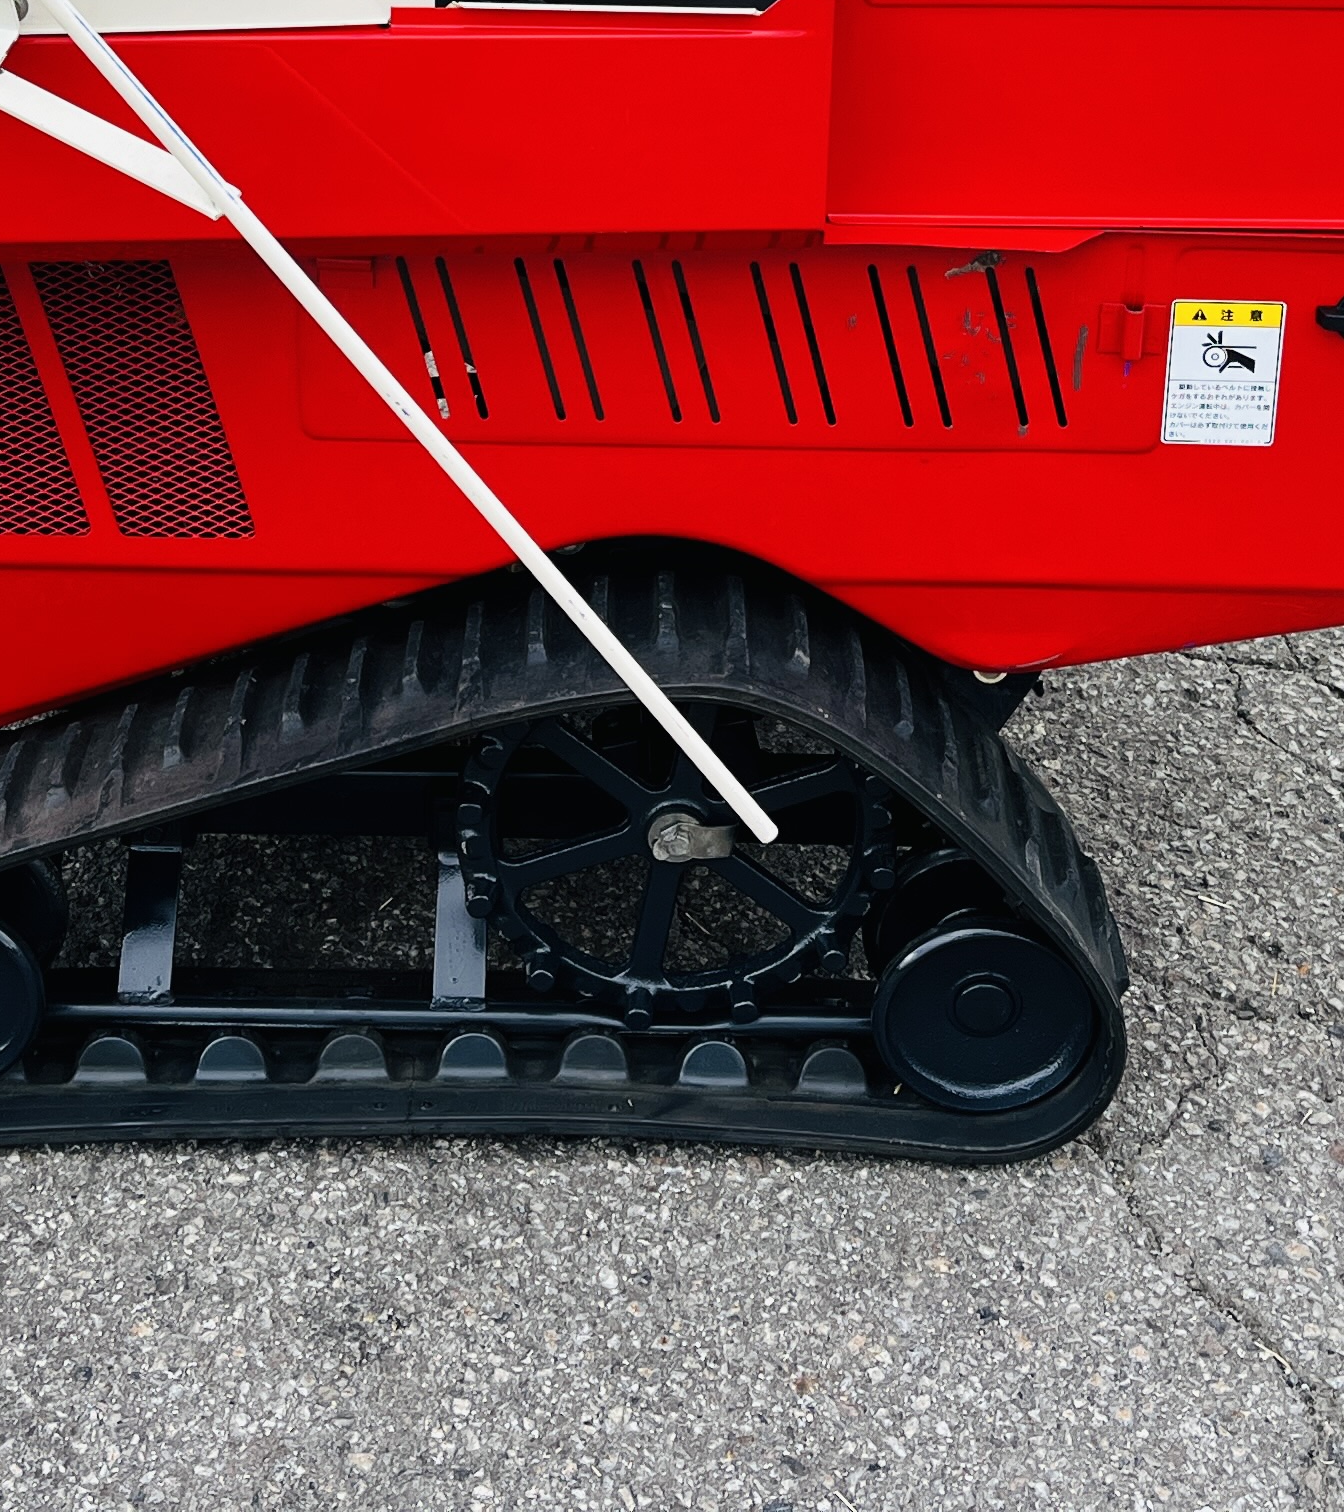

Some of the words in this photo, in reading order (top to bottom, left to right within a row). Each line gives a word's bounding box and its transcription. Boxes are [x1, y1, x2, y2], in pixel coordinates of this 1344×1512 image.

[1221, 309, 1263, 322] 注意
[1171, 393, 1268, 402] ケガをするおそれがあります。
